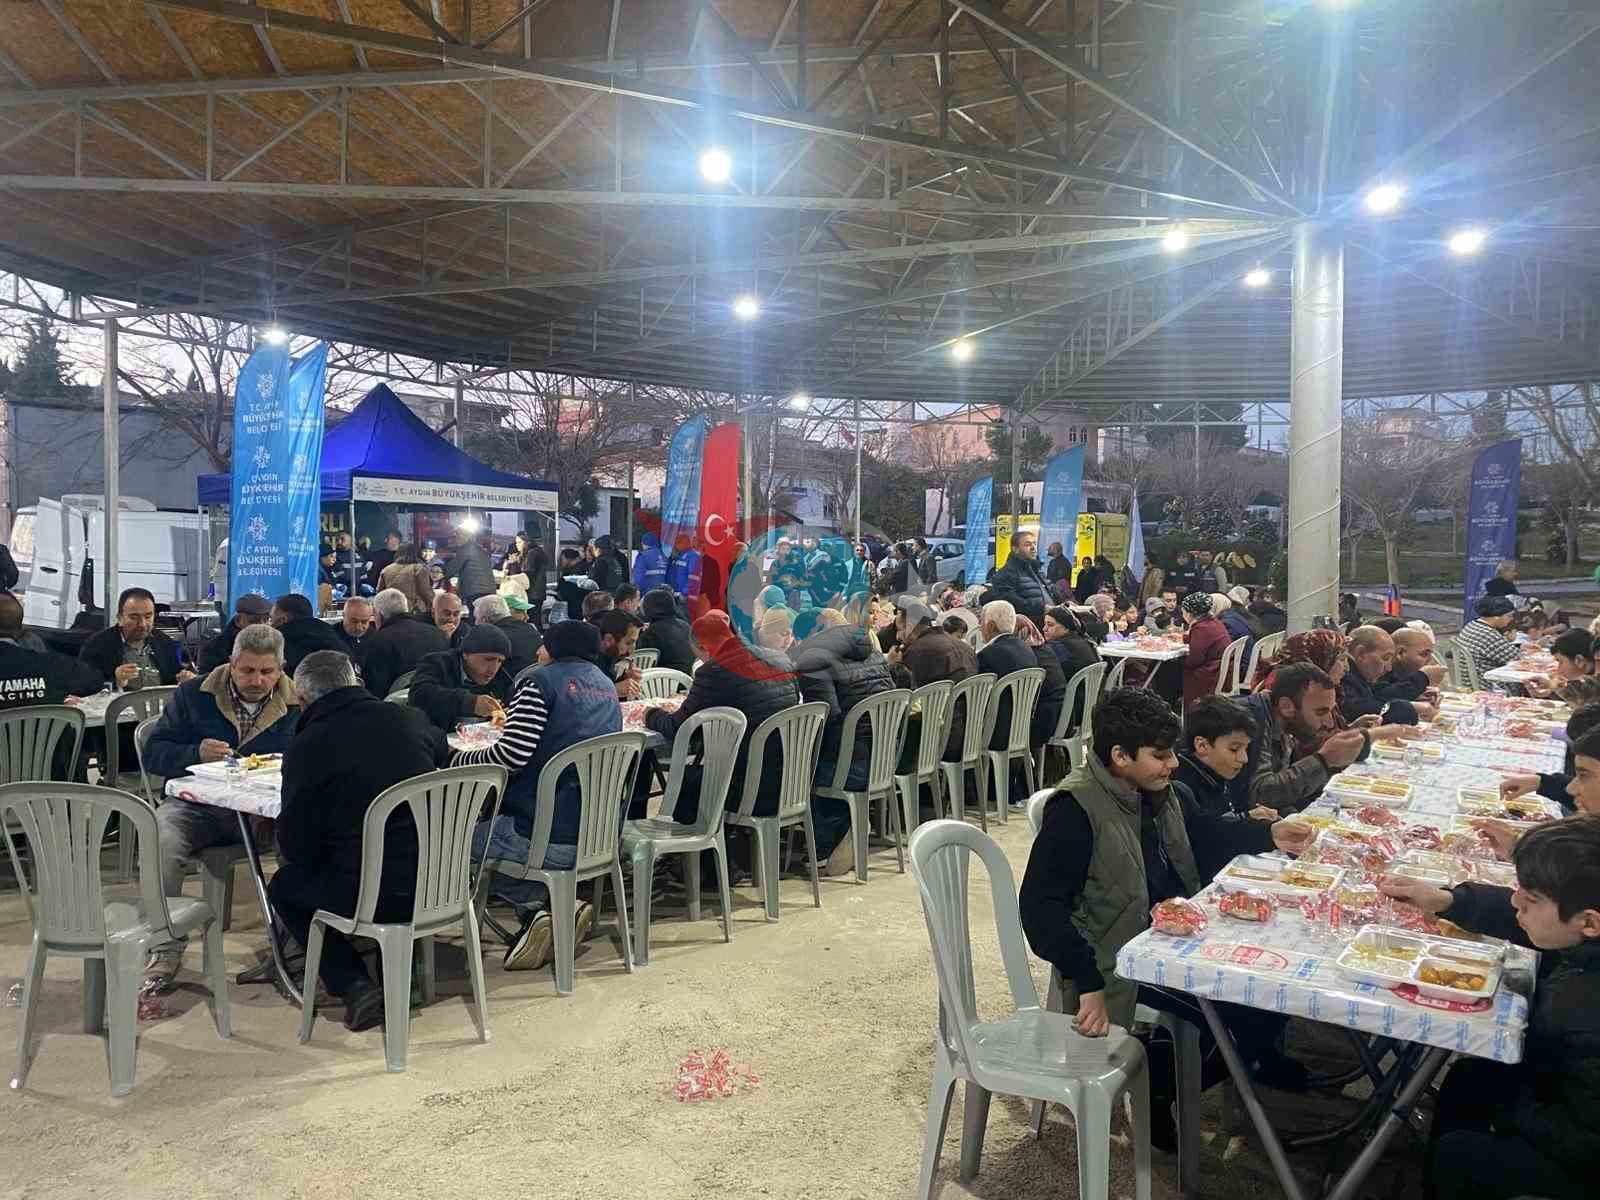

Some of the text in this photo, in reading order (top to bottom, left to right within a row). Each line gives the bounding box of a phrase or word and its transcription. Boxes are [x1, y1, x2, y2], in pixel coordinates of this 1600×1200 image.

[408, 487, 431, 497] AYDIN
[431, 487, 485, 501] BÜYÜKŞEHİR
[0, 690, 45, 701] ACING
